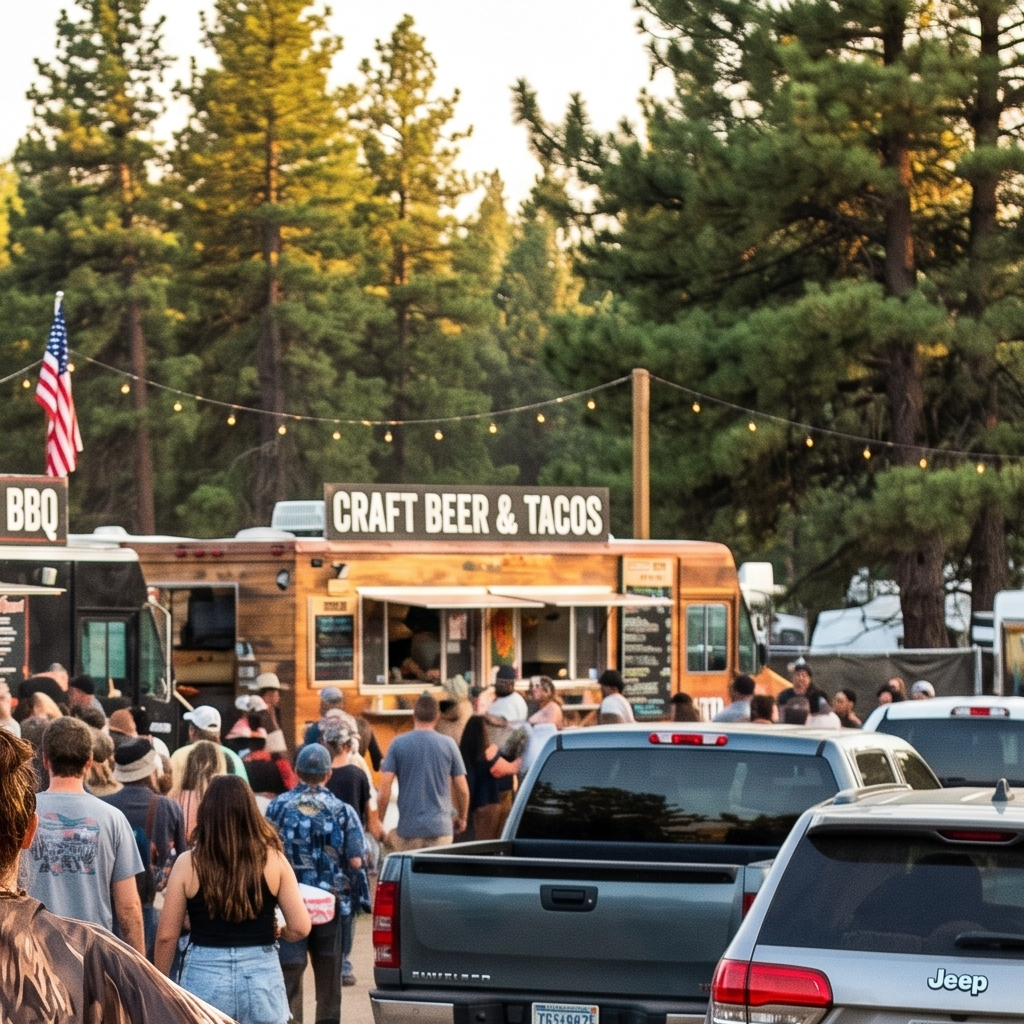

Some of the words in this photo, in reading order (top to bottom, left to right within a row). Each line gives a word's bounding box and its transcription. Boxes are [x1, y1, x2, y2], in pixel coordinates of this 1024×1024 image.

[7, 487, 58, 541] BBQ
[333, 490, 418, 533] CRAFT
[425, 492, 490, 534] BEER
[496, 493, 518, 535] &
[523, 494, 603, 536] TACOS
[927, 968, 988, 997] Jeep
